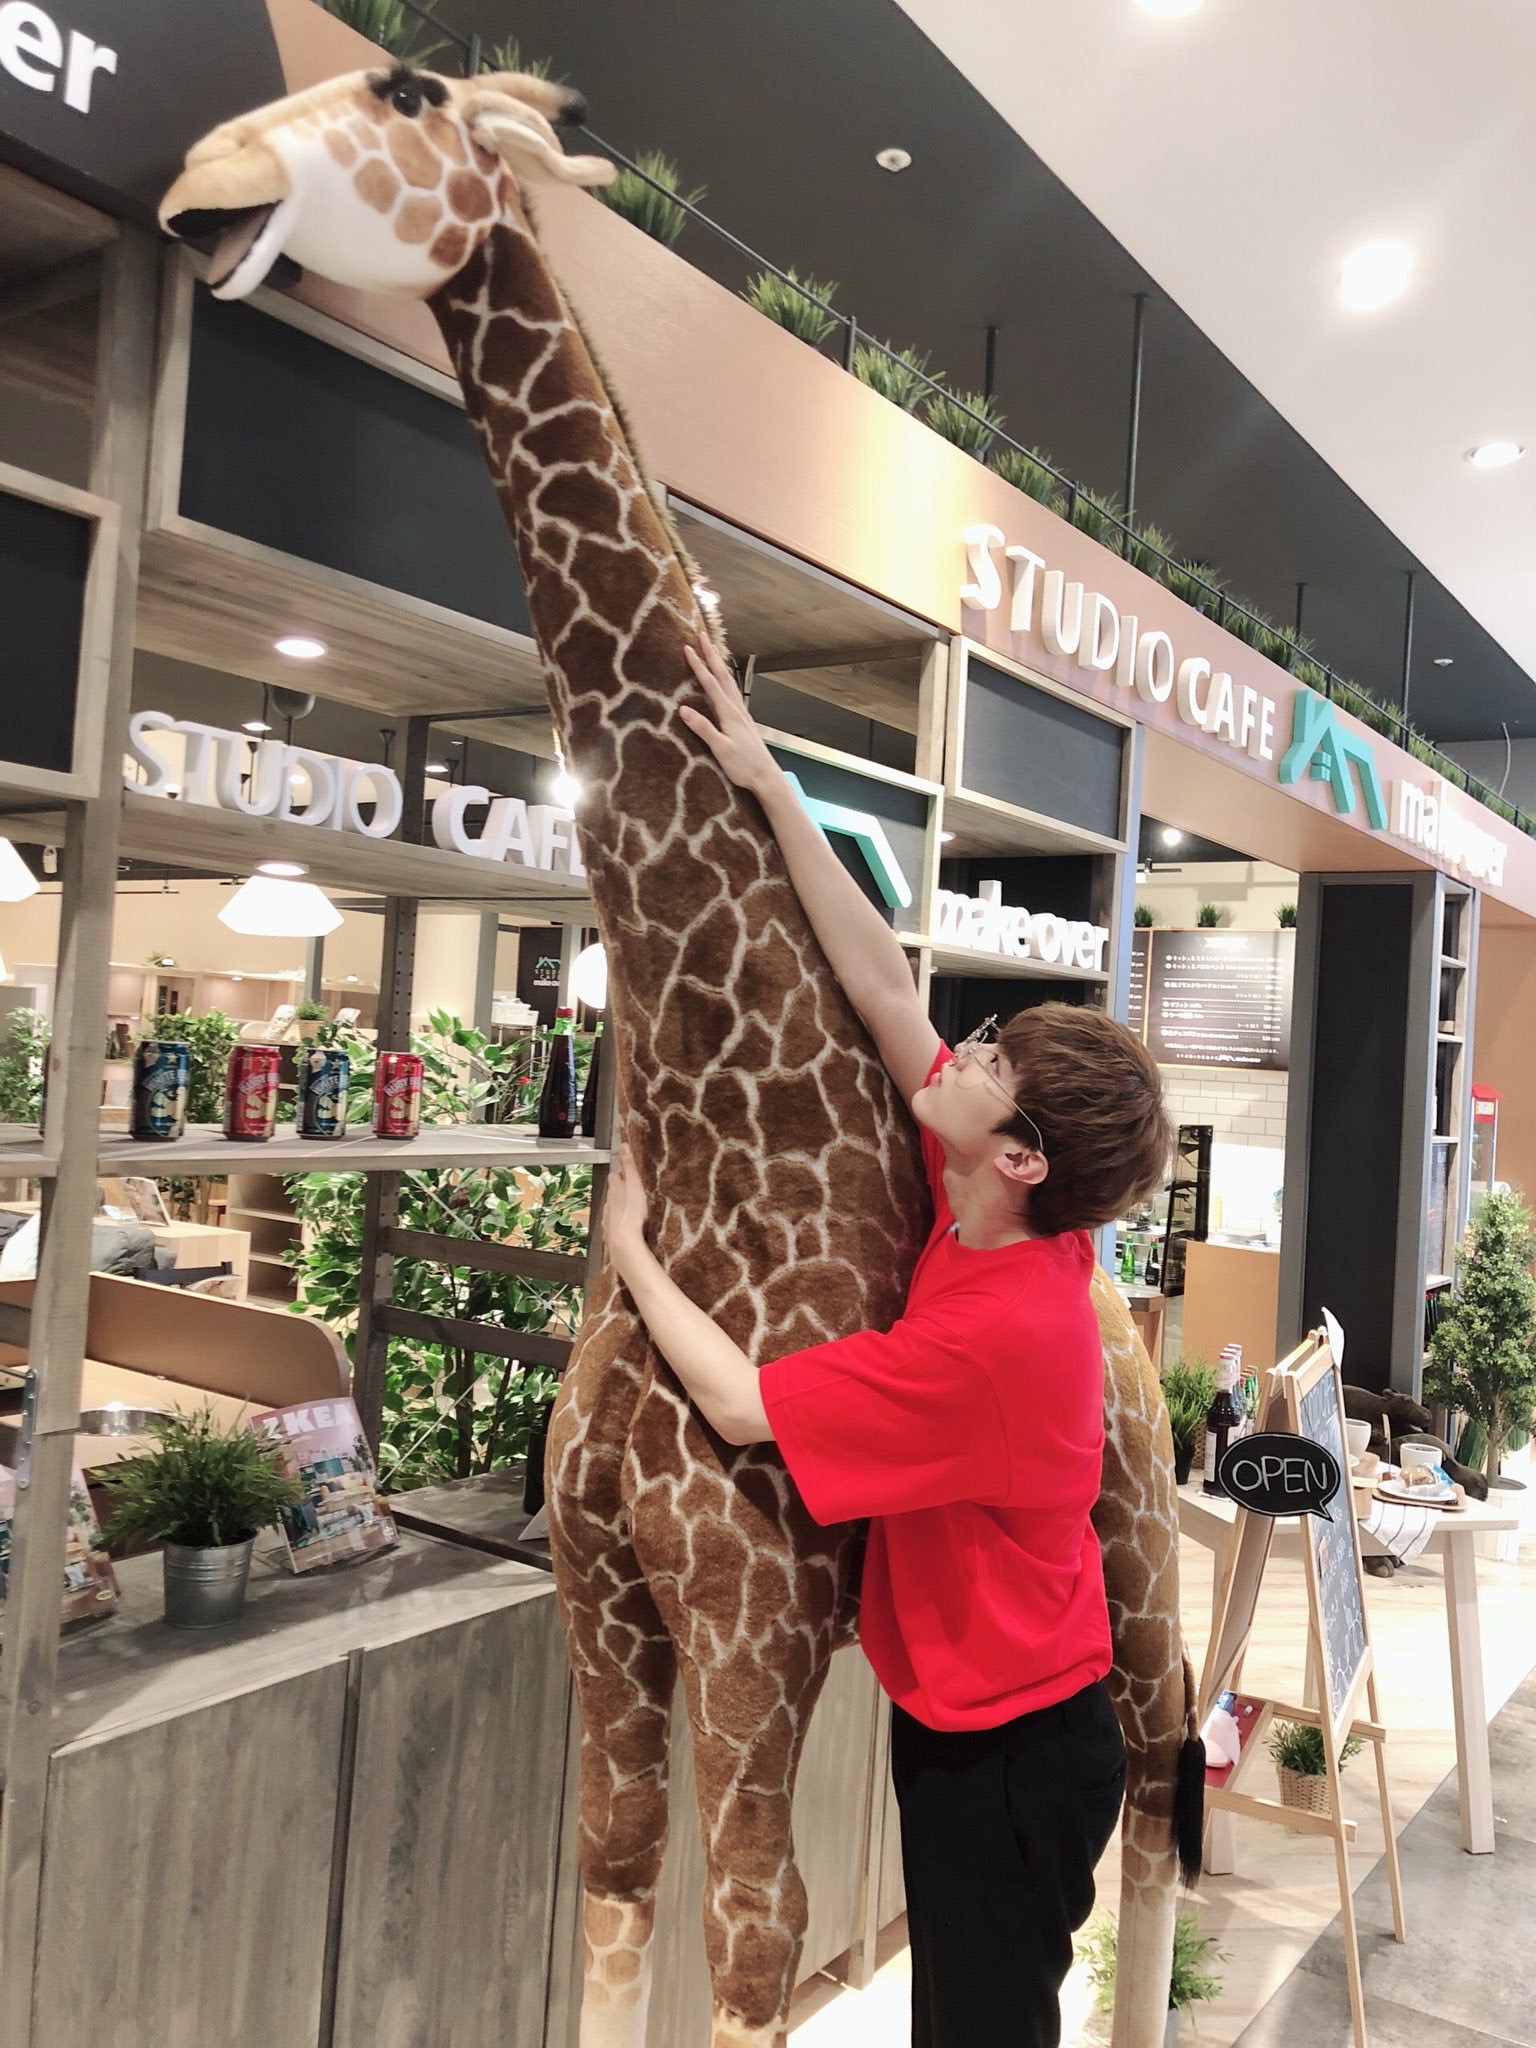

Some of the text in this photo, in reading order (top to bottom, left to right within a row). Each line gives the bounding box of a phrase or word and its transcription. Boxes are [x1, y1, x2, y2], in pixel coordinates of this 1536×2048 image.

[0, 1, 118, 114] er
[960, 523, 1276, 762] STUDIO CAFE
[123, 711, 404, 839] STUDIO
[931, 879, 1110, 972] make over
[1232, 1456, 1328, 1493] OPEN
